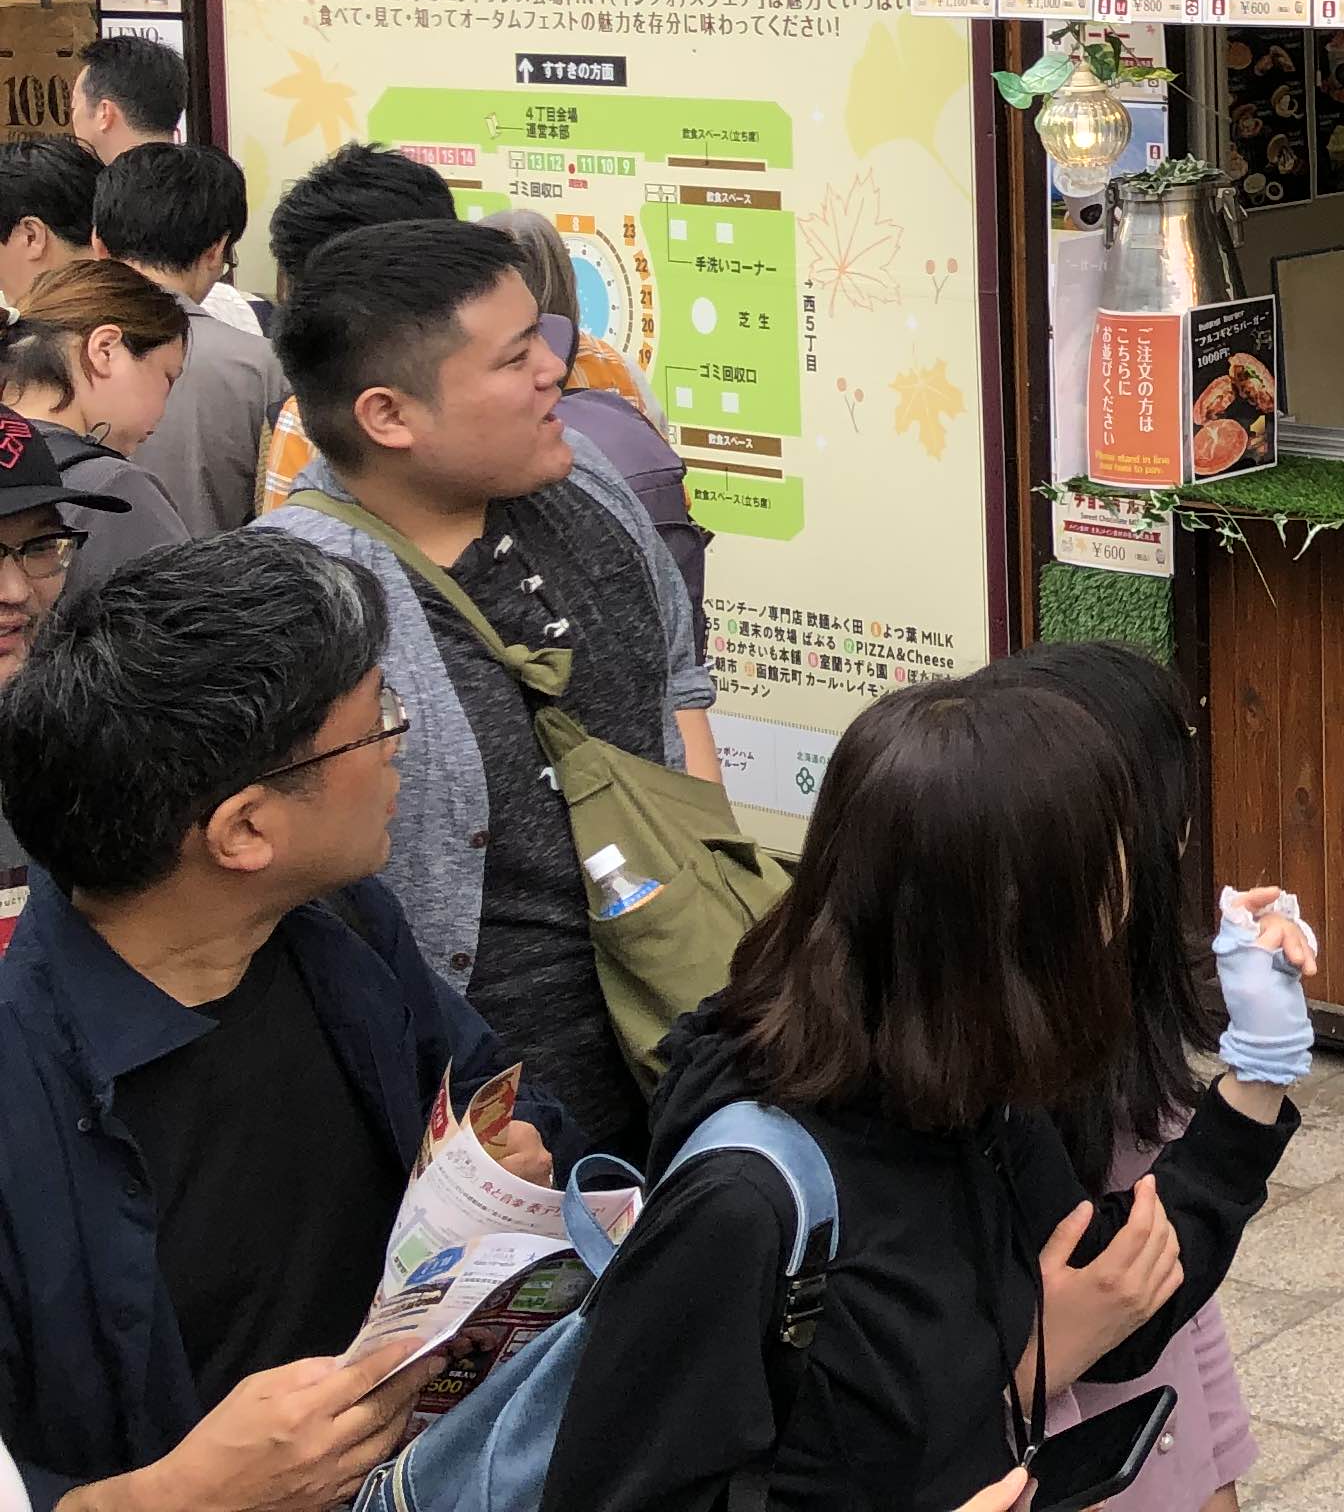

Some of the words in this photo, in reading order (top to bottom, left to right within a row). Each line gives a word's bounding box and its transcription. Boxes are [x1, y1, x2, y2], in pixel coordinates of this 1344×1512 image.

[1132, 0, 1162, 13] ¥800
[1240, 0, 1270, 15] ¥600
[541, 61, 615, 82] すすきの方面
[525, 106, 579, 124] 4丁目会場
[525, 123, 571, 141] 運営本部
[421, 148, 435, 163] 16
[441, 148, 454, 164] 15
[460, 149, 475, 165] 14
[529, 154, 543, 170] 13
[549, 154, 563, 170] 12
[580, 156, 594, 172] 11
[600, 156, 614, 174] 10
[623, 157, 631, 174] 9
[509, 181, 564, 199] ゴミ回収口
[705, 190, 752, 205] 飲食スペース
[571, 217, 580, 231] 8
[623, 224, 636, 239] 23
[635, 256, 648, 273] 22
[695, 256, 777, 273] 手洗いコーナー
[640, 289, 653, 307] 21
[641, 317, 655, 334] 20
[803, 295, 817, 372] 西5丁目
[638, 348, 652, 365] 19
[1117, 327, 1132, 396] こちらに
[699, 364, 757, 384] ゴミ回収口
[1137, 327, 1154, 433] ご注文の方は
[708, 434, 754, 450] 飲食スペース
[1092, 542, 1126, 561] ¥600
[738, 620, 798, 645] 週末の牧場
[802, 632, 836, 650] ばぶる
[856, 640, 955, 669] PIZZA&Cheese
[922, 630, 954, 649] MILK
[755, 663, 802, 682] 函館元町
